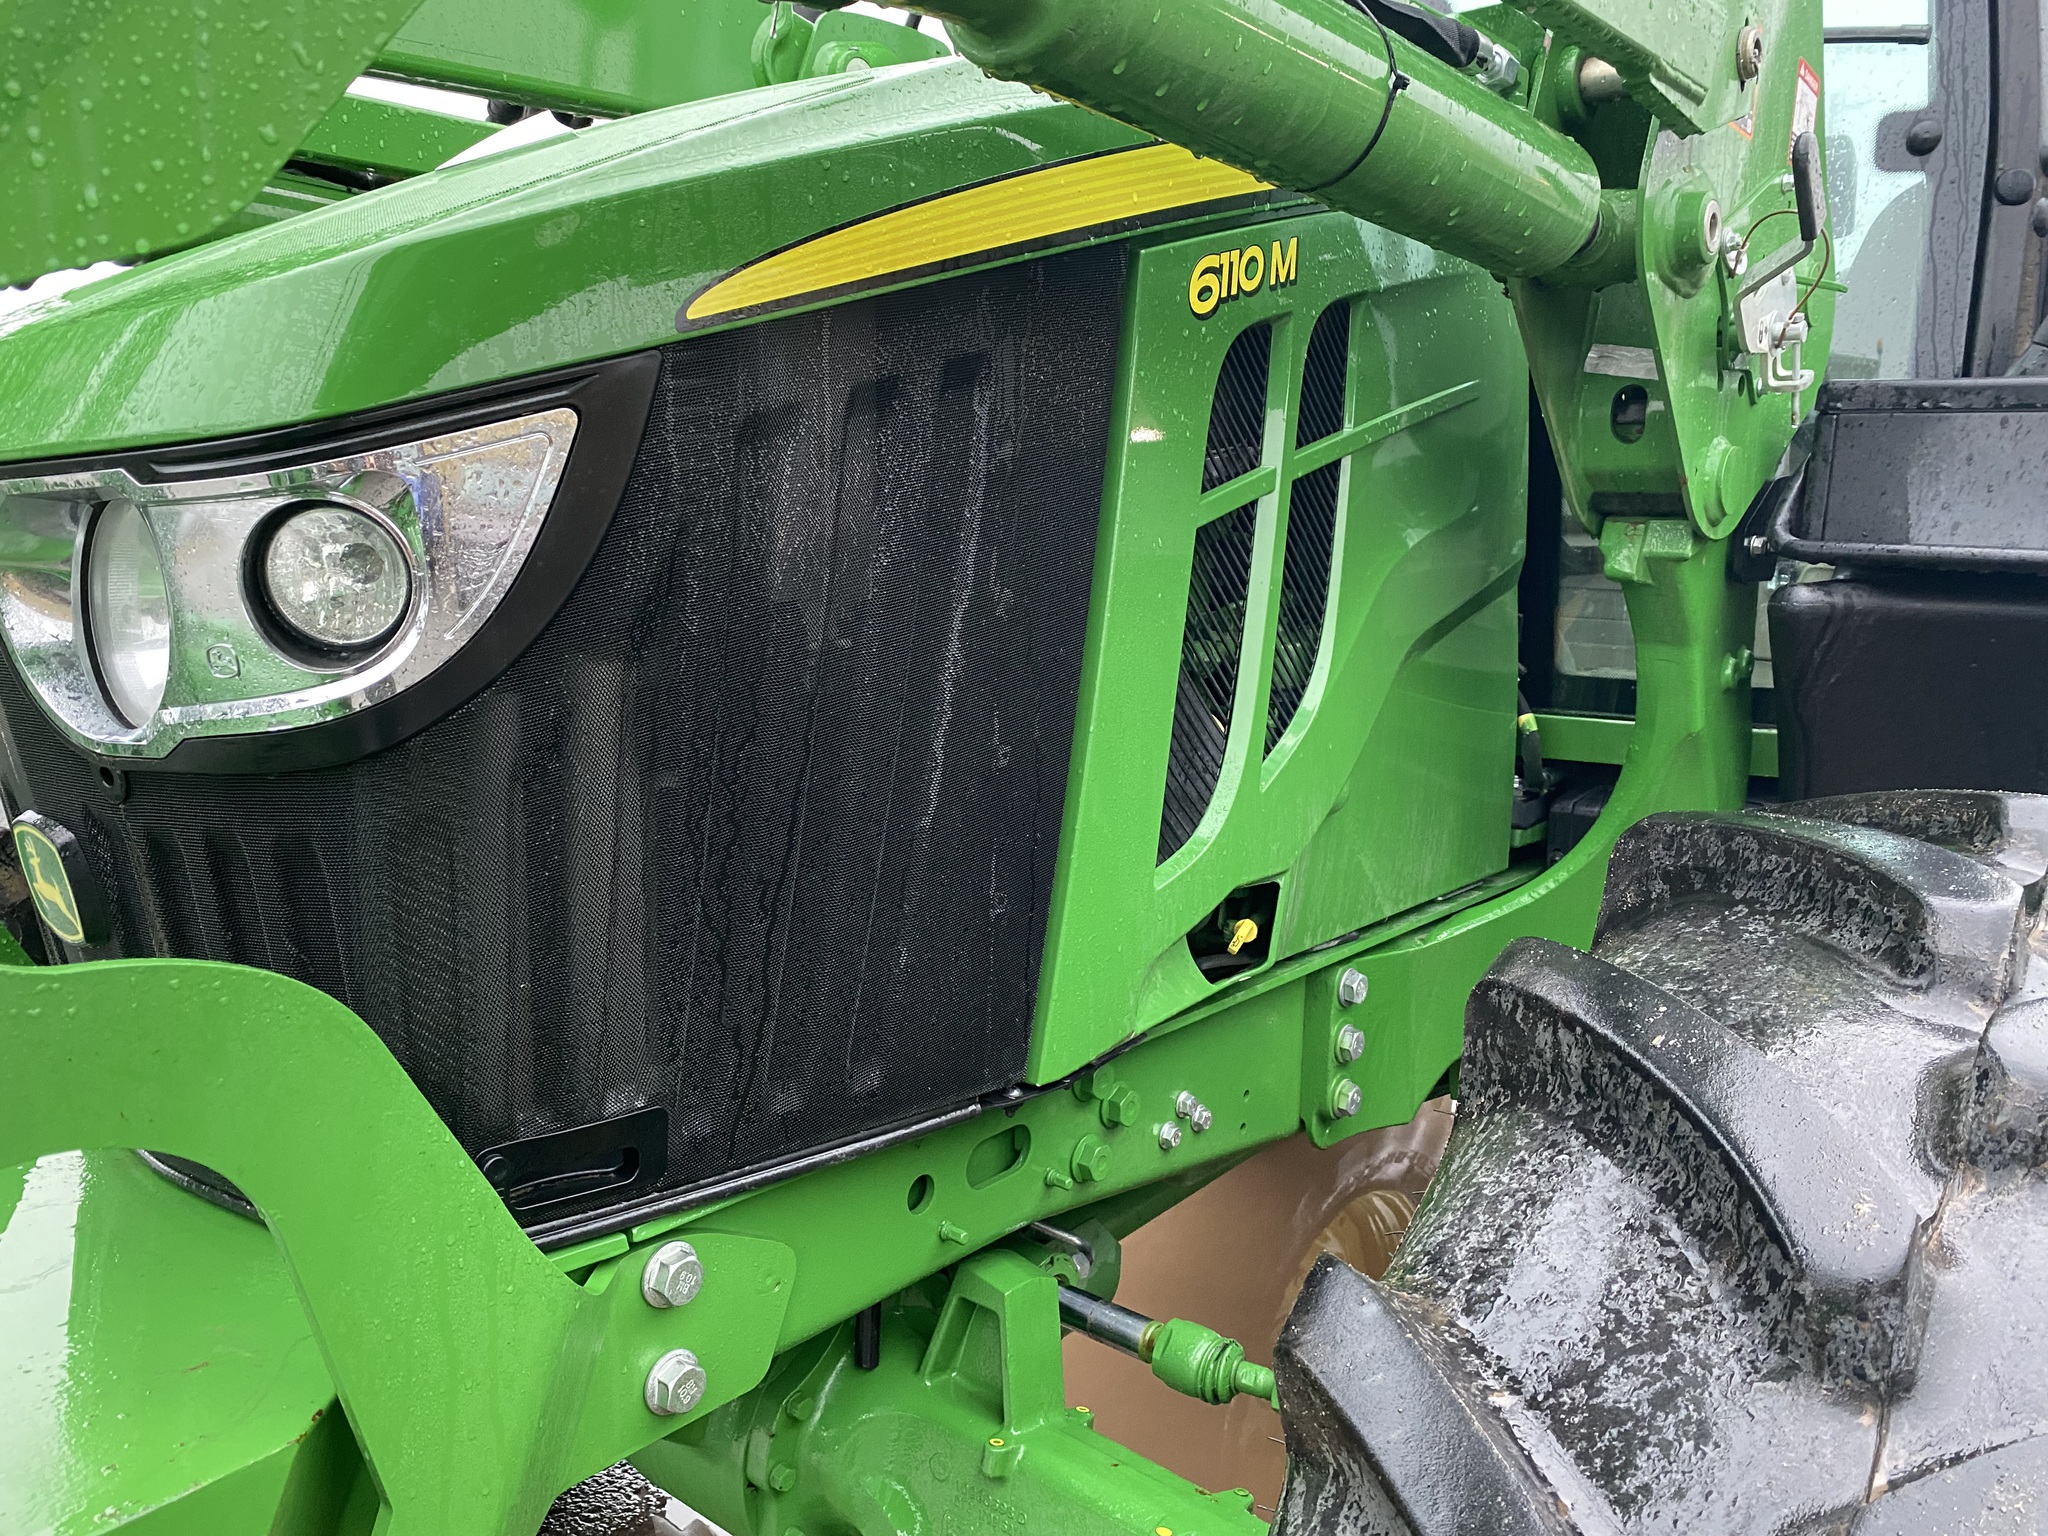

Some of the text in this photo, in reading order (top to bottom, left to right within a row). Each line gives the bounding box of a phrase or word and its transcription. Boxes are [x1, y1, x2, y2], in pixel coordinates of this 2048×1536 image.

[1189, 236, 1298, 319] 6110 M
[679, 1270, 697, 1286] 10.9
[677, 1384, 691, 1404] 10.9
